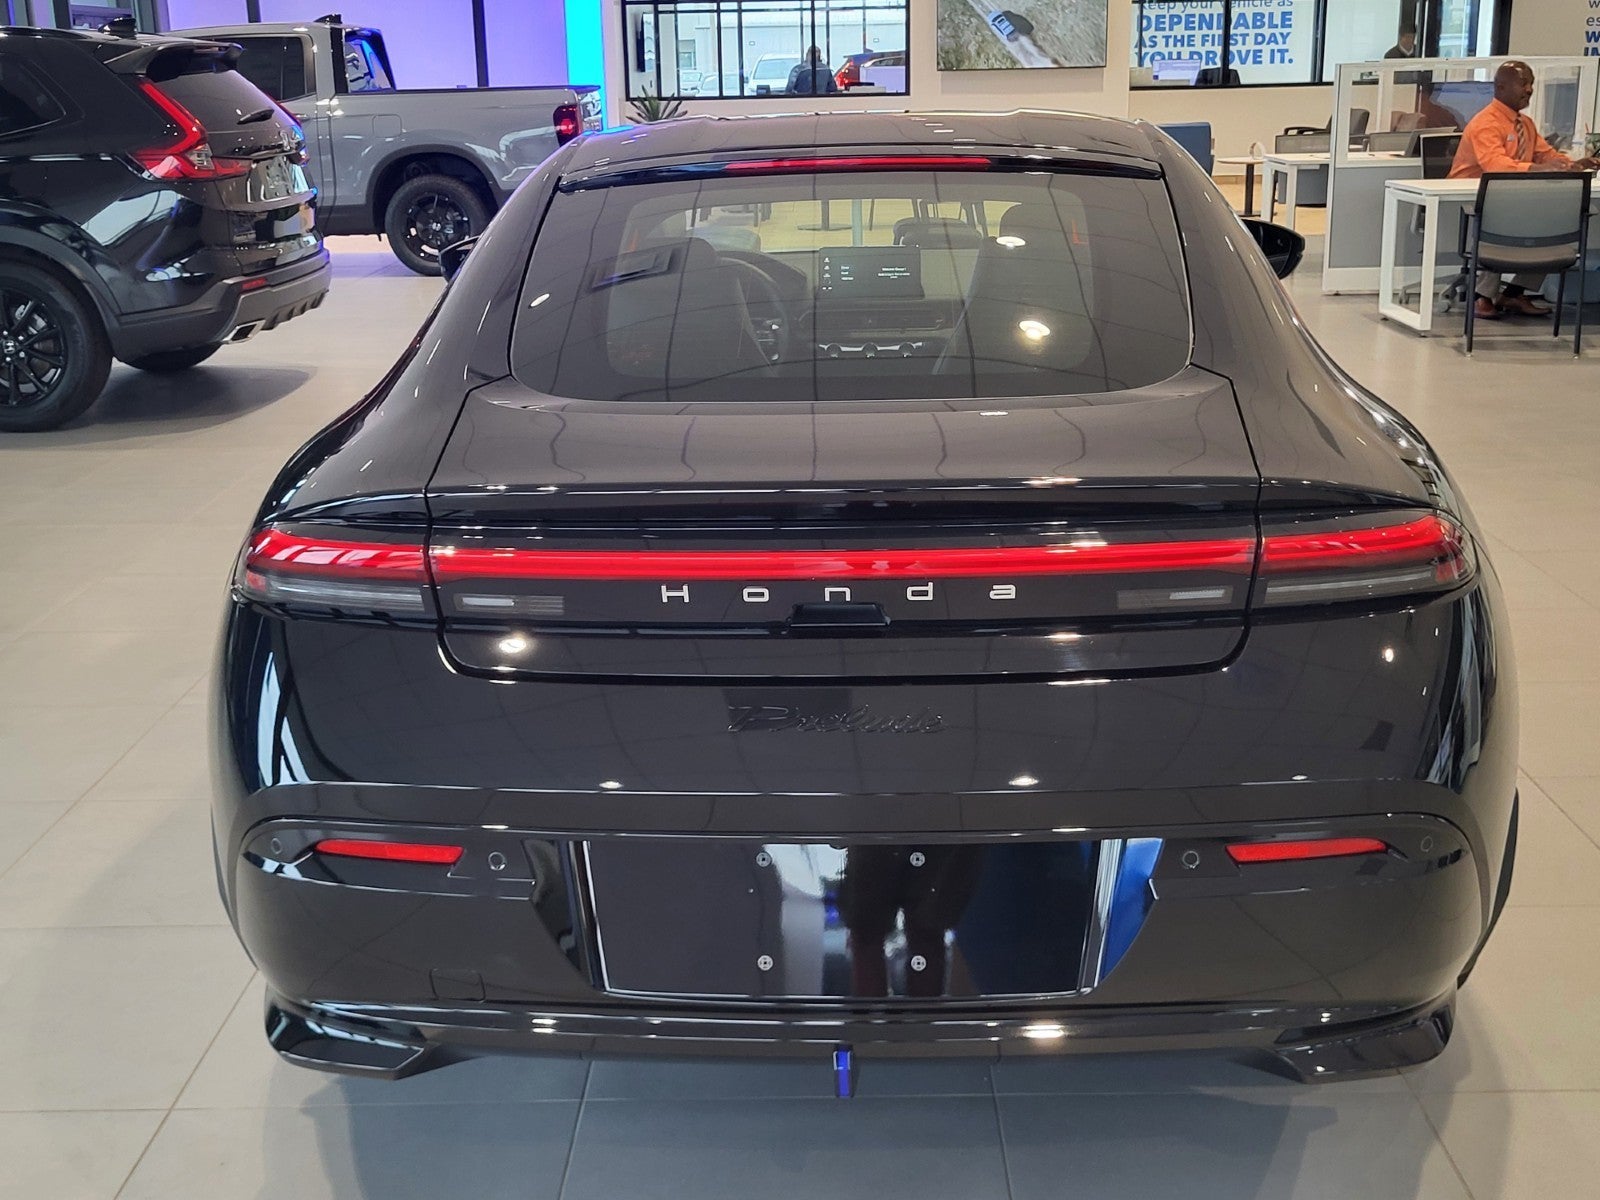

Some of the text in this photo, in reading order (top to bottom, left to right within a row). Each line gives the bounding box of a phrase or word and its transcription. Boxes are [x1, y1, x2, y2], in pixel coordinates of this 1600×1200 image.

[1182, 1, 1213, 13] your
[1134, 35, 1157, 48] AS
[1162, 34, 1196, 47] THE
[1254, 32, 1291, 45] DAY
[1270, 48, 1294, 64] IT.
[726, 704, 945, 733] Prelude
